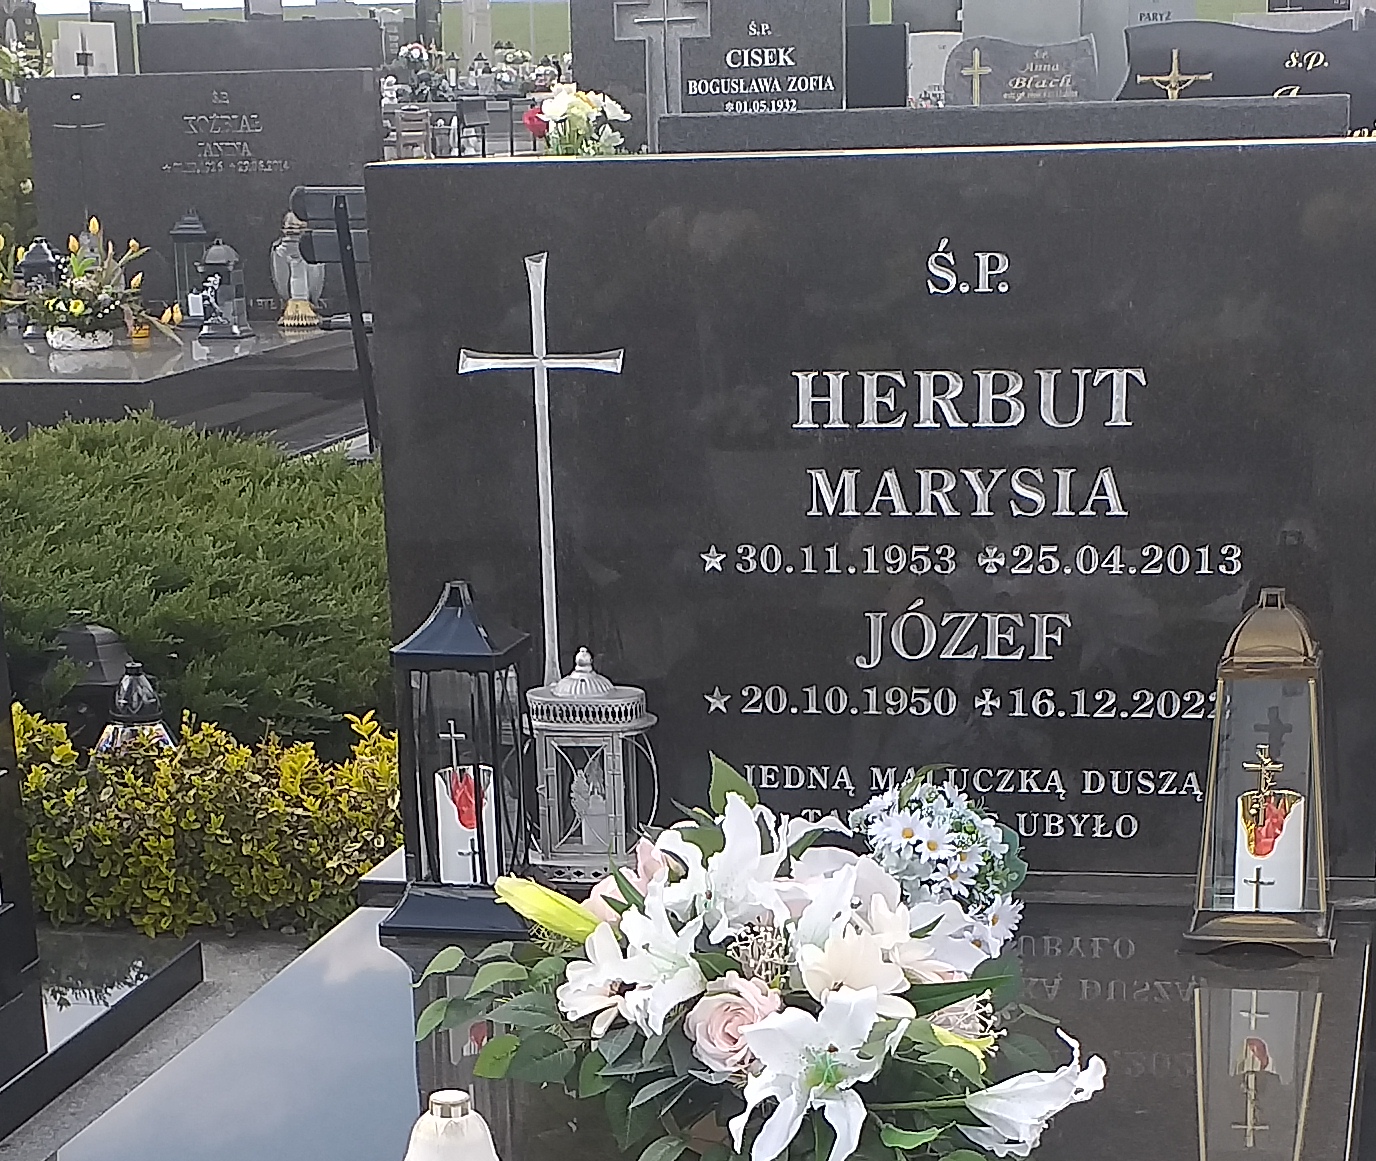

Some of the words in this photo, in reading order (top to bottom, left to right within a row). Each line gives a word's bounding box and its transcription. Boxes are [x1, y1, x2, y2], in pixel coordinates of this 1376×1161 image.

[748, 20, 772, 36] Ś.P.
[725, 46, 796, 68] CISEK
[687, 77, 781, 95] BOGUSŁAWA
[787, 75, 835, 92] ZOFIA
[926, 237, 1010, 294] Ś.P.
[790, 368, 1148, 429] HERBUT
[806, 466, 1130, 517] MARYSIA
[734, 543, 957, 576] 30.11.1953
[1010, 543, 1244, 576] 25.04.2013
[855, 598, 1072, 669] JÓZEF
[739, 685, 957, 717] 20.10.1950
[1080, 769, 1204, 802] DUSZĄ
[1015, 812, 1140, 839] UBYŁO
